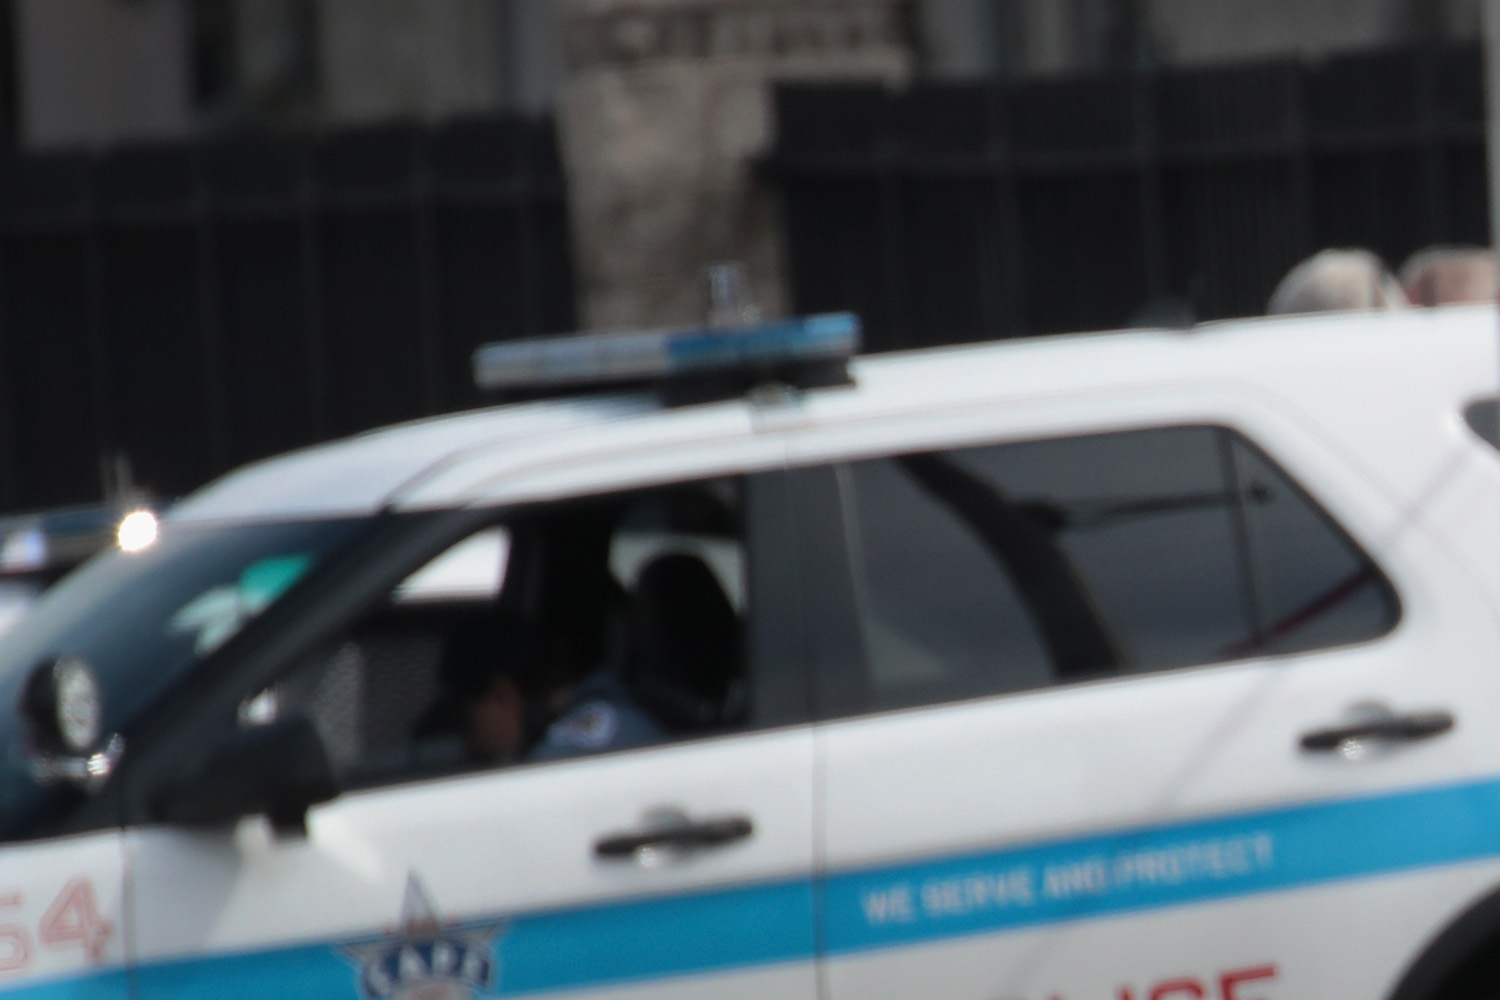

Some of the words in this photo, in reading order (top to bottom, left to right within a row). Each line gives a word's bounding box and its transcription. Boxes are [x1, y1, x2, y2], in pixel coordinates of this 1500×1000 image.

[863, 883, 915, 925] WE
[921, 867, 1034, 918] SERVE
[1043, 857, 1107, 898] AND
[1113, 832, 1273, 888] PROTECT
